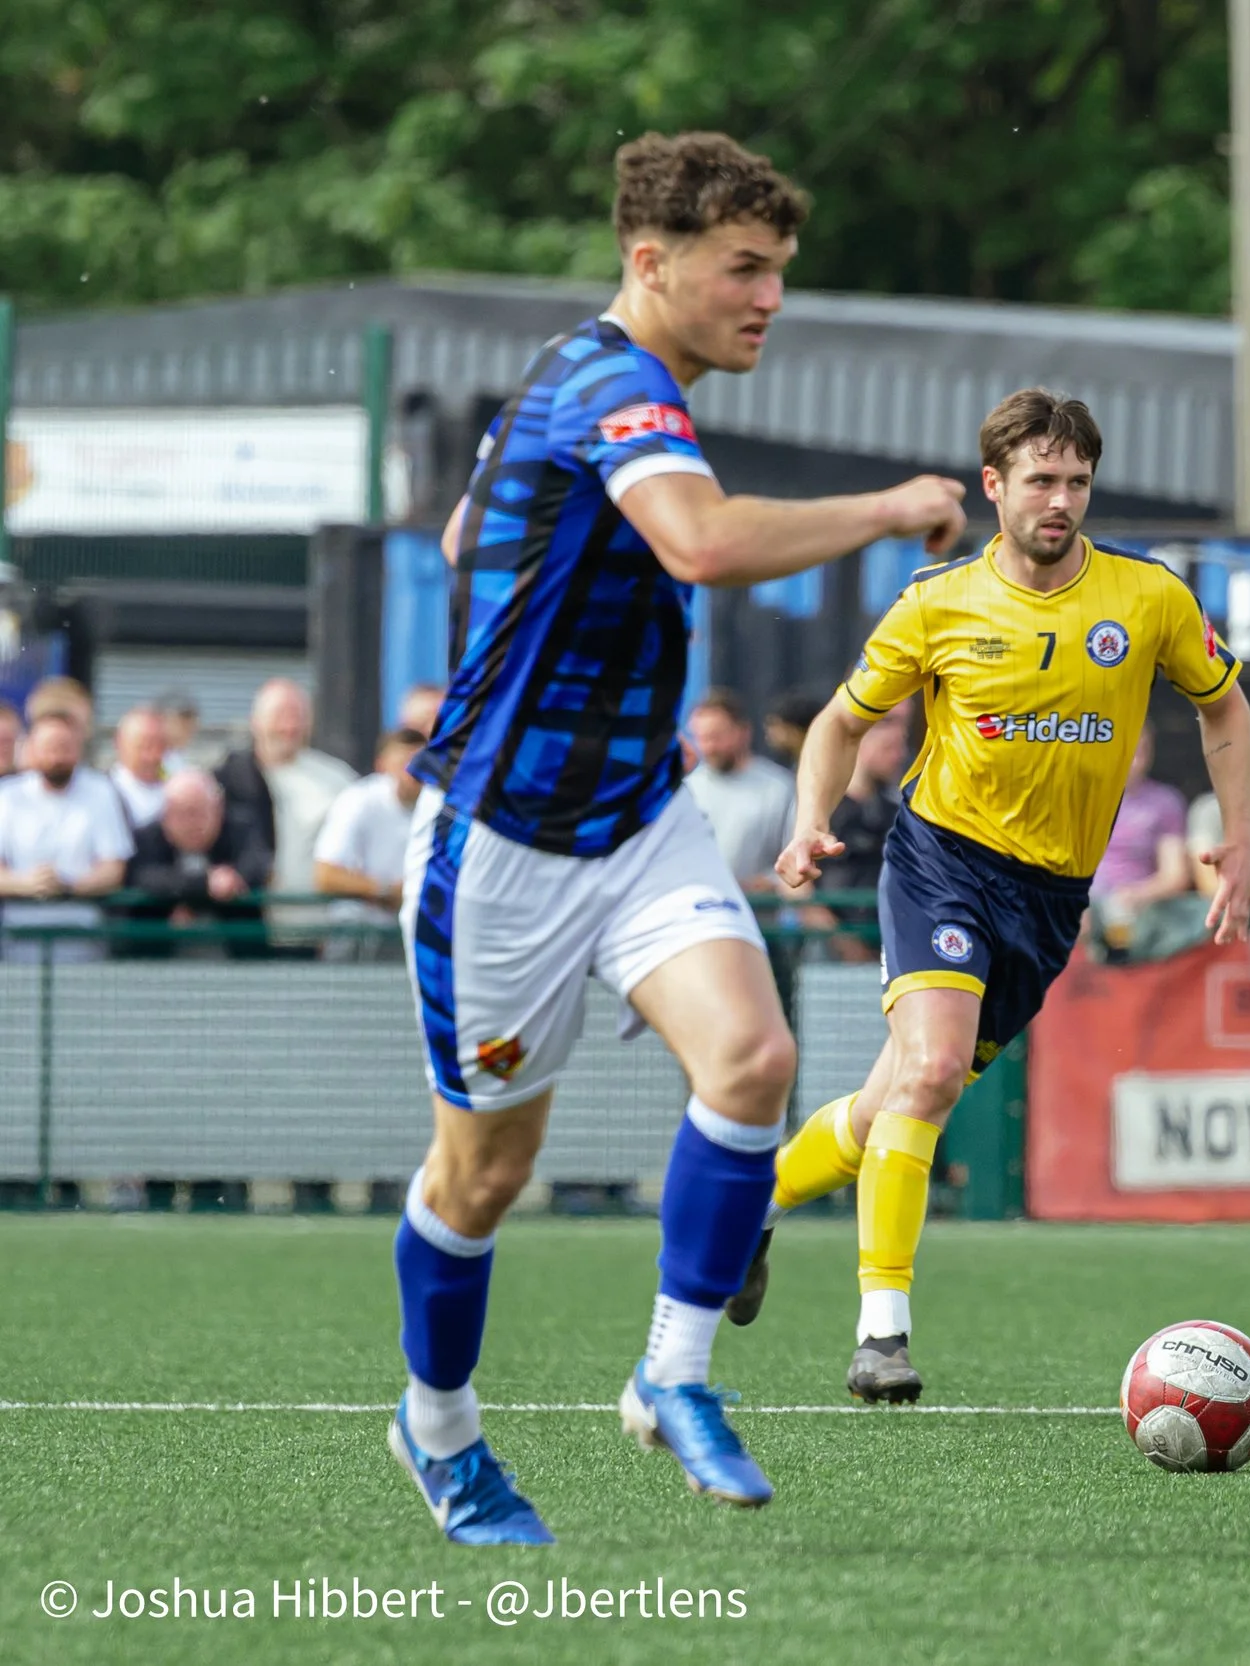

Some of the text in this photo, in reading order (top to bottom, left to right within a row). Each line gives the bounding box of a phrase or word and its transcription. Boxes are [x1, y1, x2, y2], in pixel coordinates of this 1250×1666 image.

[1037, 632, 1056, 670] 7
[1004, 712, 1114, 743] Fidelis
[1162, 1341, 1248, 1382] chryso
